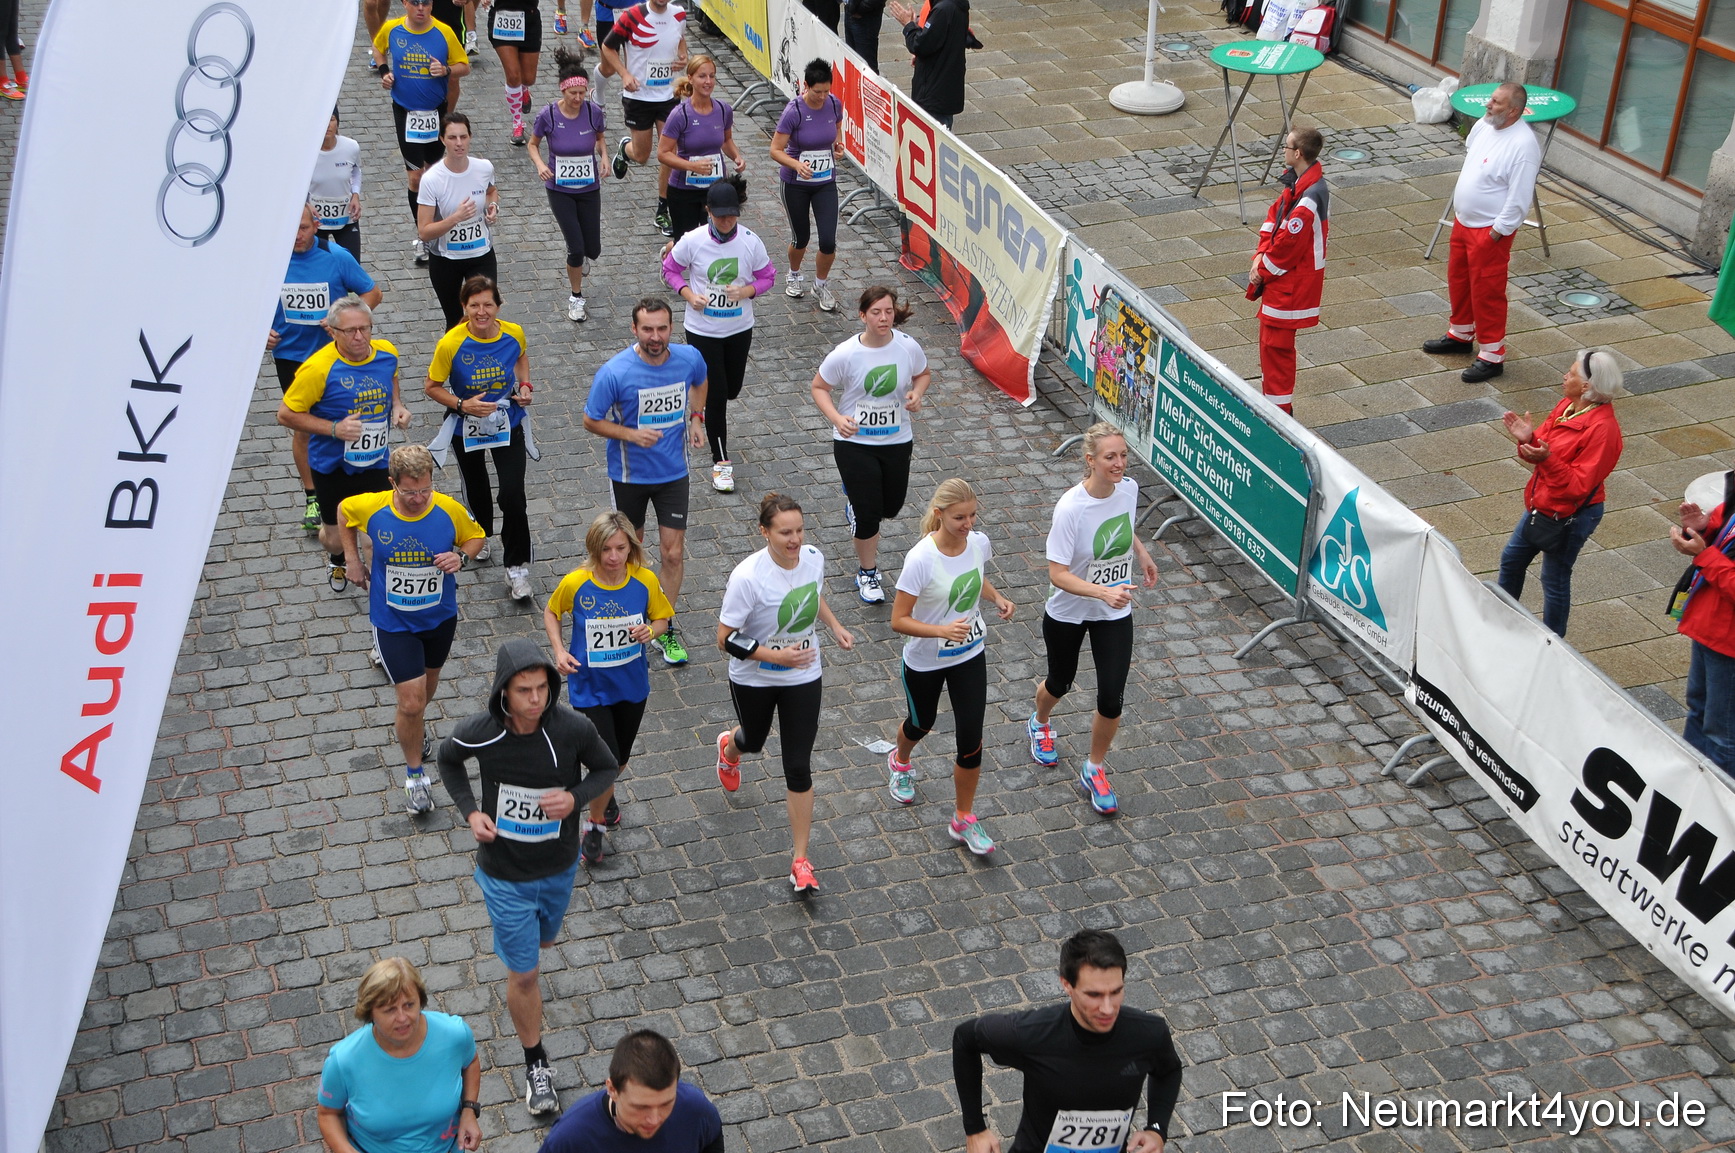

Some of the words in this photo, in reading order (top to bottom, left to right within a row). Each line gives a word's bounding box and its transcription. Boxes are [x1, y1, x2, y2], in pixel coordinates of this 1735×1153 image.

[497, 17, 522, 30] 3392
[410, 118, 437, 130] 2248
[560, 164, 591, 178] 2233
[315, 204, 347, 218] 2837
[450, 224, 482, 242] 2878
[286, 294, 325, 309] 2290
[644, 394, 682, 414] 2255
[1183, 370, 1252, 437] Event-Leit-Systeme
[651, 415, 674, 424] Roland
[859, 409, 895, 426] 2051
[865, 428, 889, 436] Sabrina
[1161, 391, 1192, 432] Mehr
[1193, 419, 1252, 488] Sicherheit
[1158, 417, 1176, 446] für
[1177, 434, 1194, 462] Ihr
[1195, 451, 1234, 500] Event!
[1156, 452, 1173, 476] Miet
[1173, 468, 1180, 483] &
[1180, 474, 1205, 506] Service
[1205, 498, 1223, 524] Line:
[1223, 515, 1246, 544] 09181
[1246, 537, 1267, 563] 6352
[60, 572, 144, 796] Audi
[104, 327, 194, 530] BKK
[387, 569, 407, 577] PARTL
[1091, 562, 1129, 585] 2360
[391, 577, 438, 595] 2576
[608, 621, 635, 629] Neumarkt
[1311, 584, 1341, 612] Gebäude
[1341, 605, 1366, 631] Service
[1366, 625, 1389, 648] GmbH
[603, 650, 631, 661] Justyna
[1413, 685, 1462, 736] istungen,
[1462, 730, 1475, 751] die
[1475, 745, 1526, 801] verbinden
[500, 788, 523, 799] PARTL
[504, 798, 551, 821] 254
[515, 824, 543, 835] Daniel
[1558, 820, 1709, 968] stadtwerke
[1058, 1124, 1122, 1146] 2781
